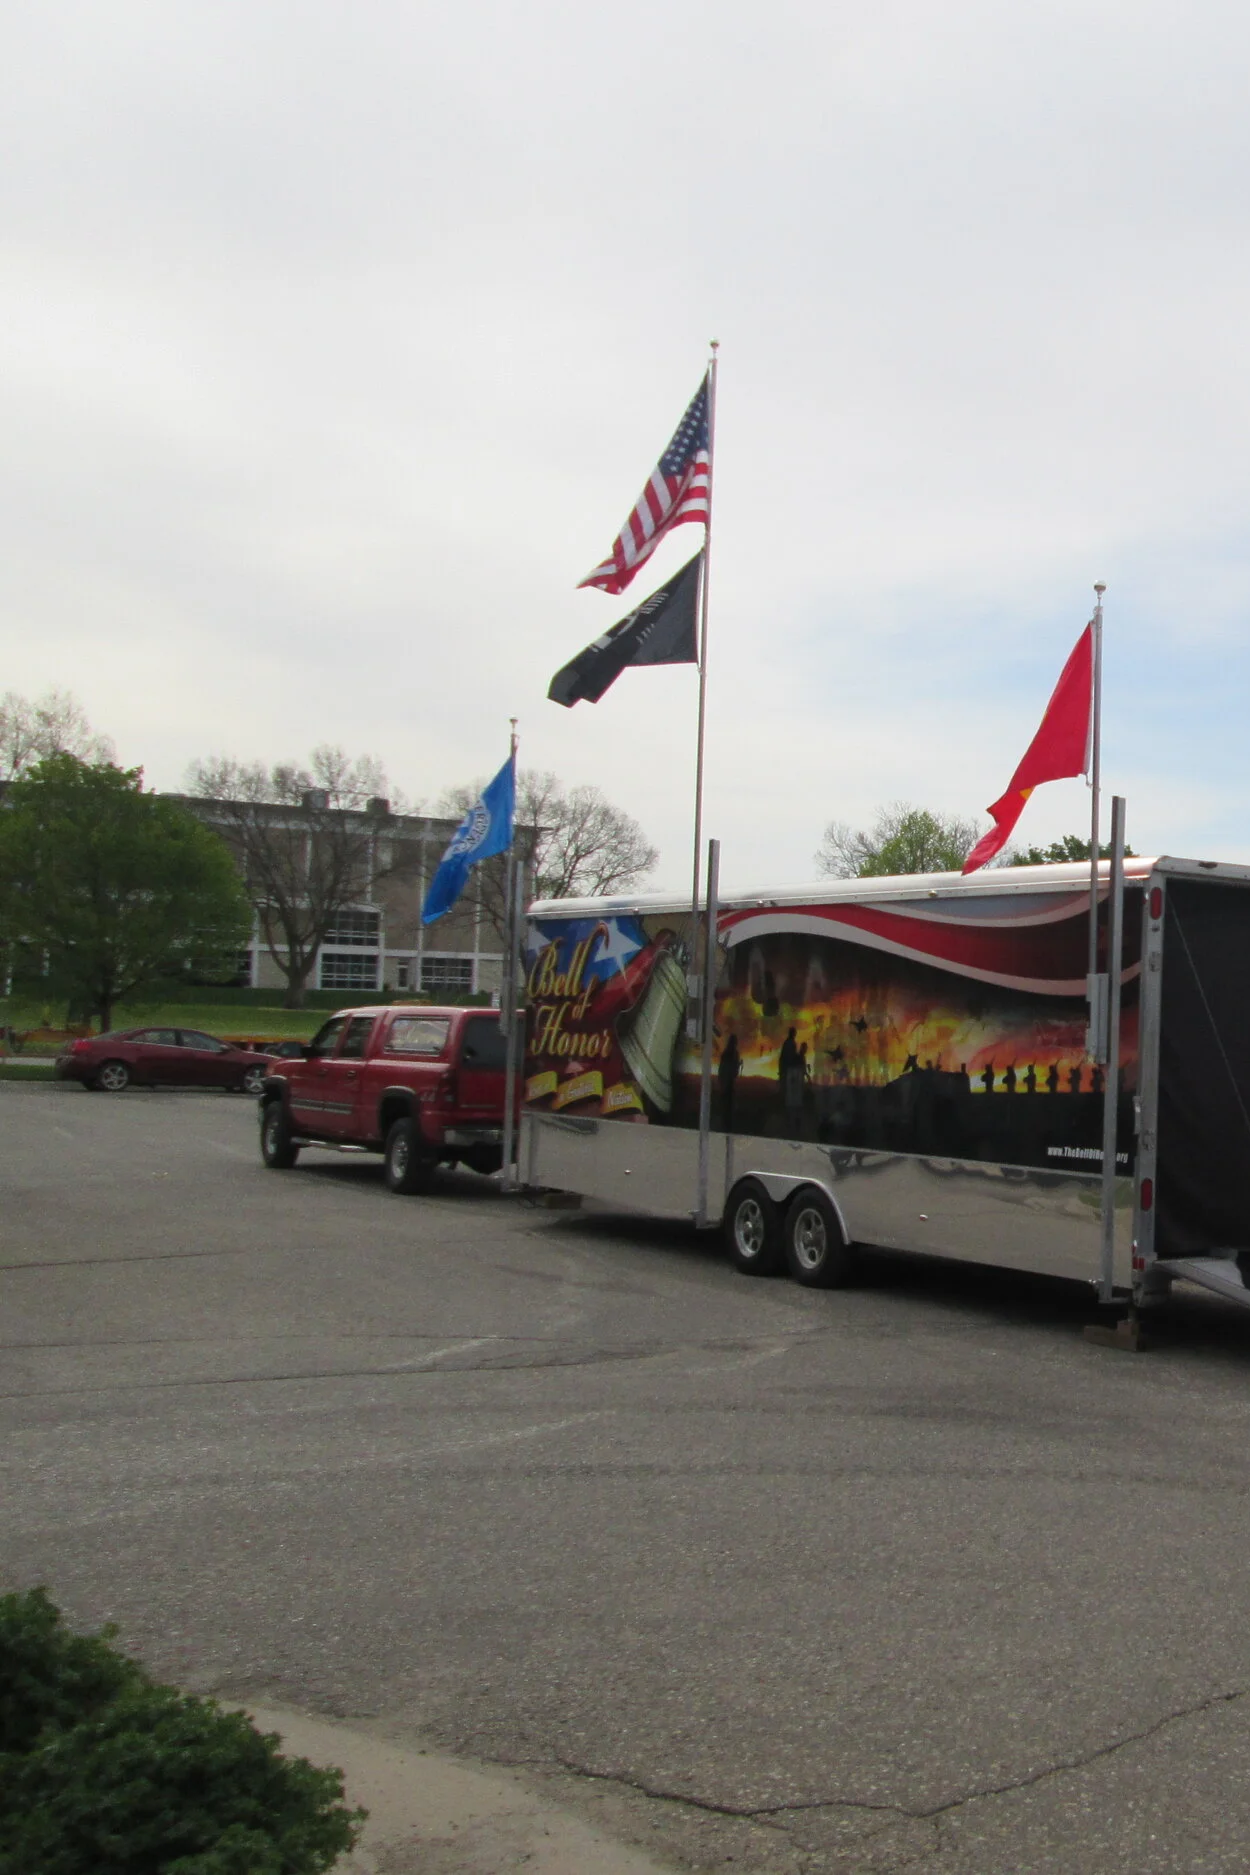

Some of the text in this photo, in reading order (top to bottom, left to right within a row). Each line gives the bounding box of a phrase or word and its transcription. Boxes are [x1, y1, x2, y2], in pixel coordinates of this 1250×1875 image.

[528, 922, 610, 998] Bell
[571, 974, 599, 1020] of
[530, 1001, 612, 1058] Honor
